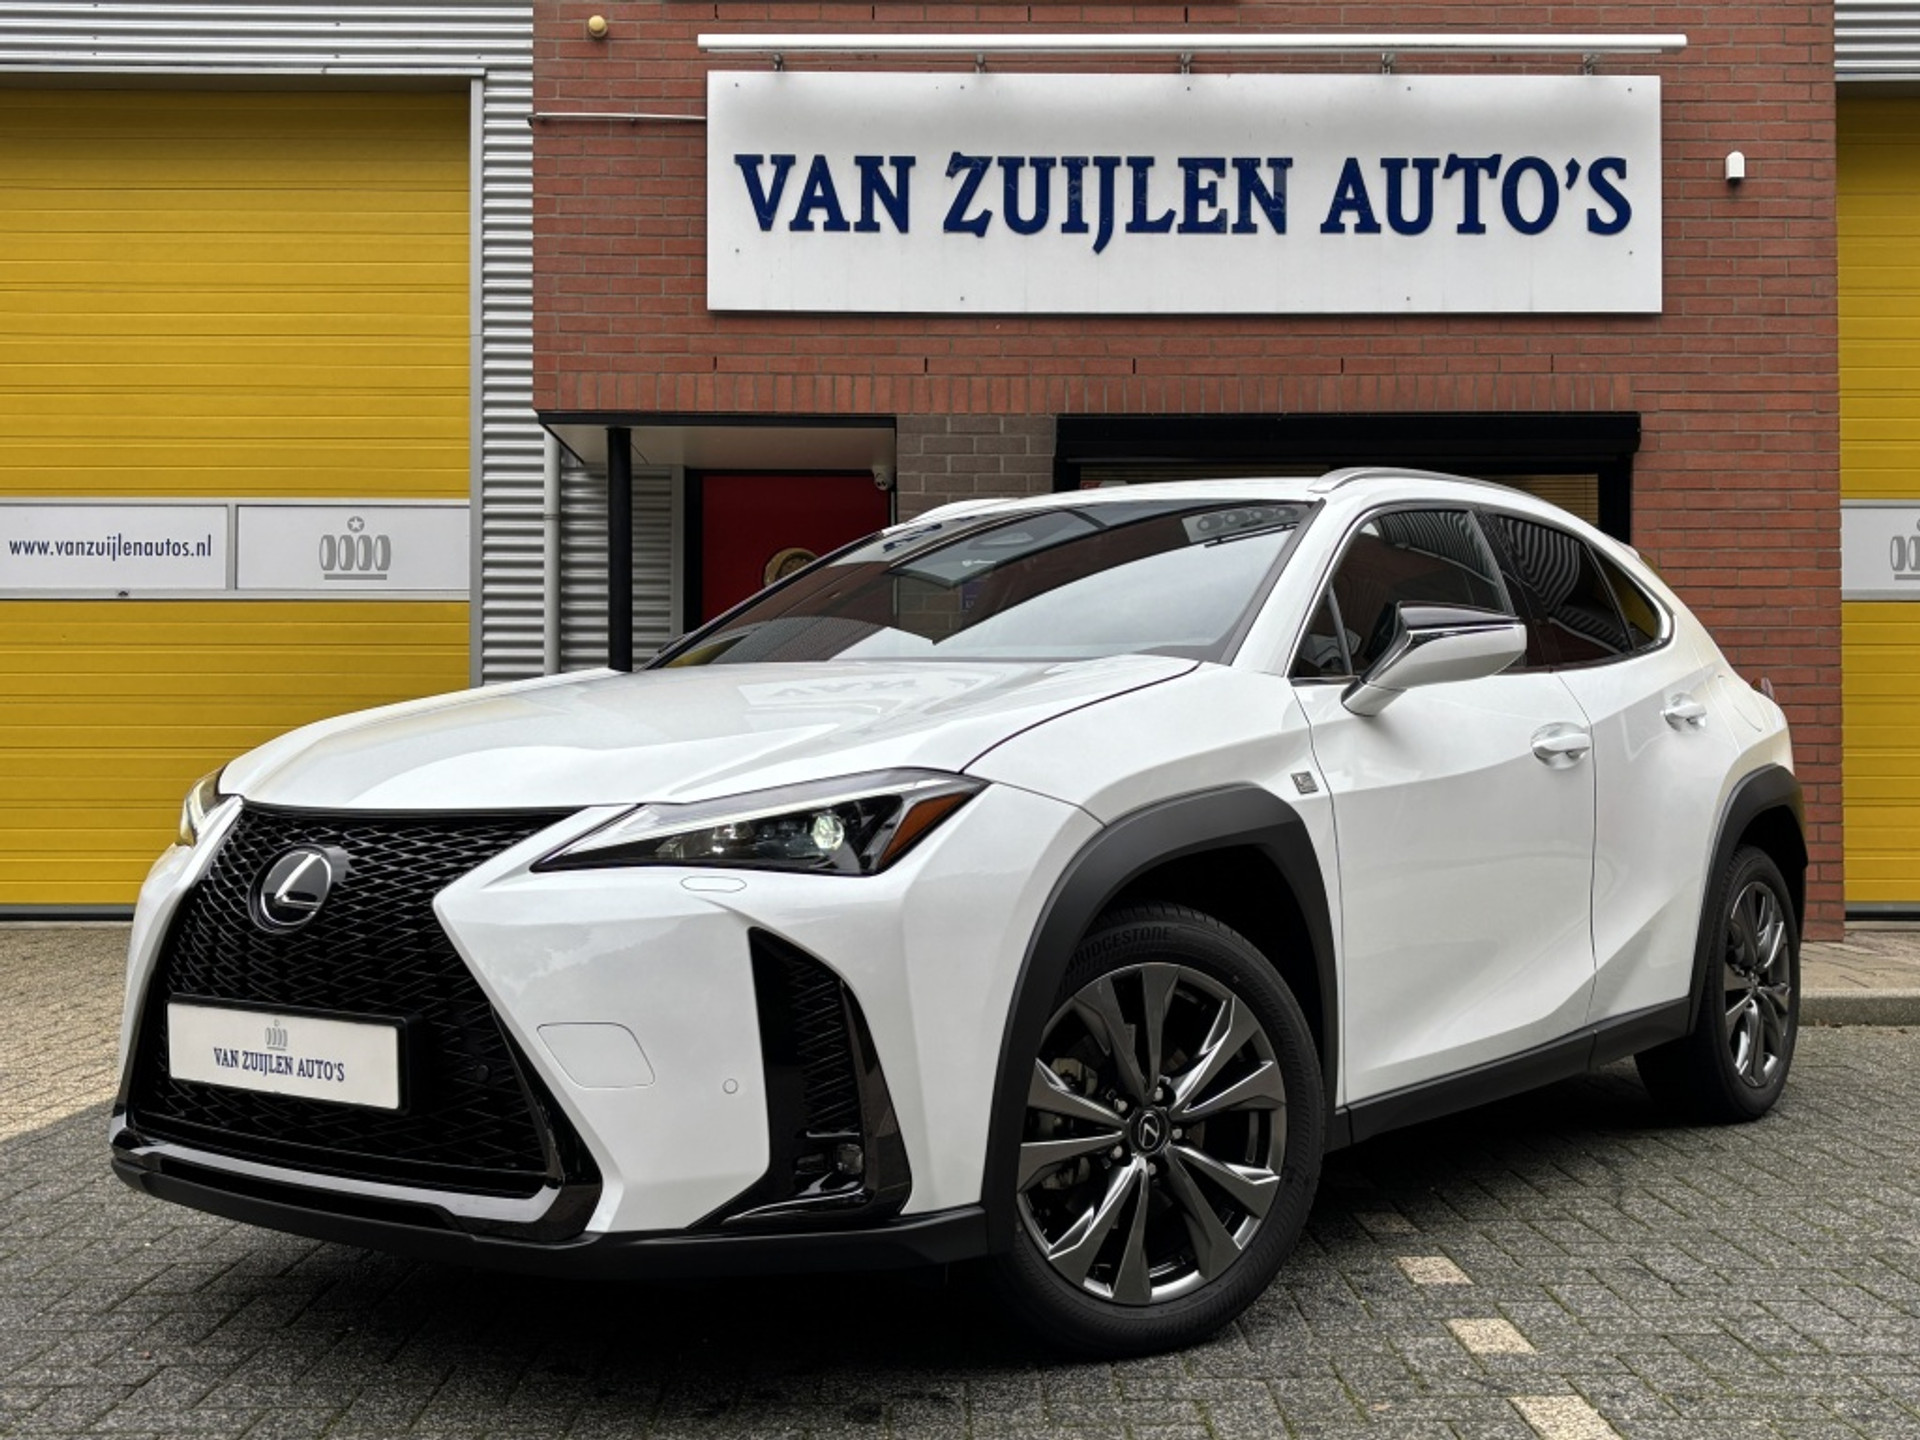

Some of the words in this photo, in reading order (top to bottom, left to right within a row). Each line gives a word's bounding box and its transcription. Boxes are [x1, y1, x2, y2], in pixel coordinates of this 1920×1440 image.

[734, 154, 916, 234] VAN
[943, 151, 1293, 254] ZUIJLEN
[1320, 153, 1632, 236] AUTO'S
[9, 533, 212, 561] www.vanzuijlenautos.nl
[213, 1047, 239, 1068] VAN
[242, 1051, 294, 1076] ZUIJLEN
[297, 1058, 345, 1082] AUTO'S
